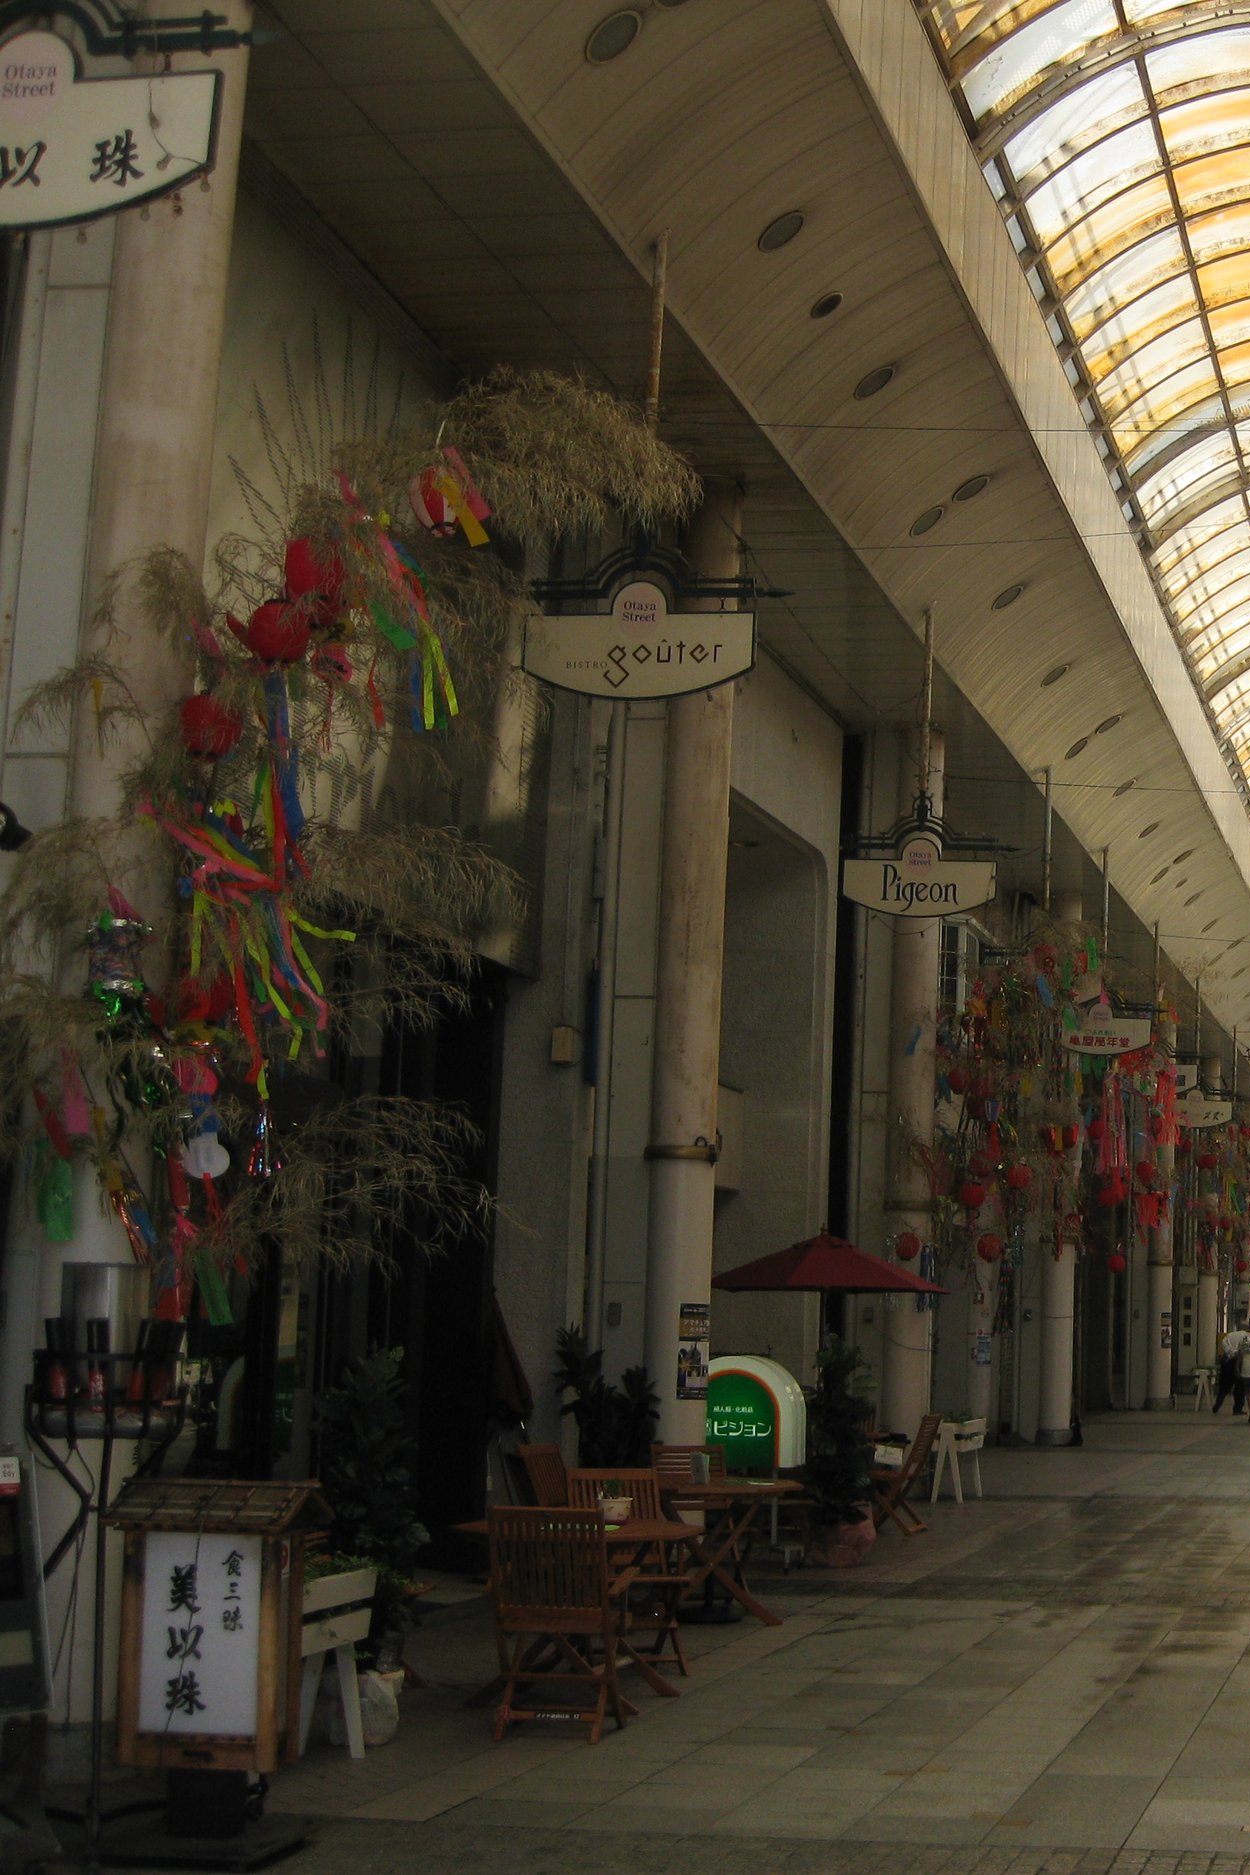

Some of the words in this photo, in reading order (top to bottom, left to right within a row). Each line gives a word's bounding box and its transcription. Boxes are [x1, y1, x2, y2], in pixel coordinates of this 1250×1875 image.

[5, 64, 57, 79] Otaya
[2, 82, 56, 98] Street
[624, 601, 656, 612] Otaya
[623, 612, 656, 622] Street
[566, 661, 608, 669] BISTRO
[603, 639, 722, 688] goûter
[880, 864, 959, 912] Pigeon
[166, 1564, 206, 1716] 美以珠
